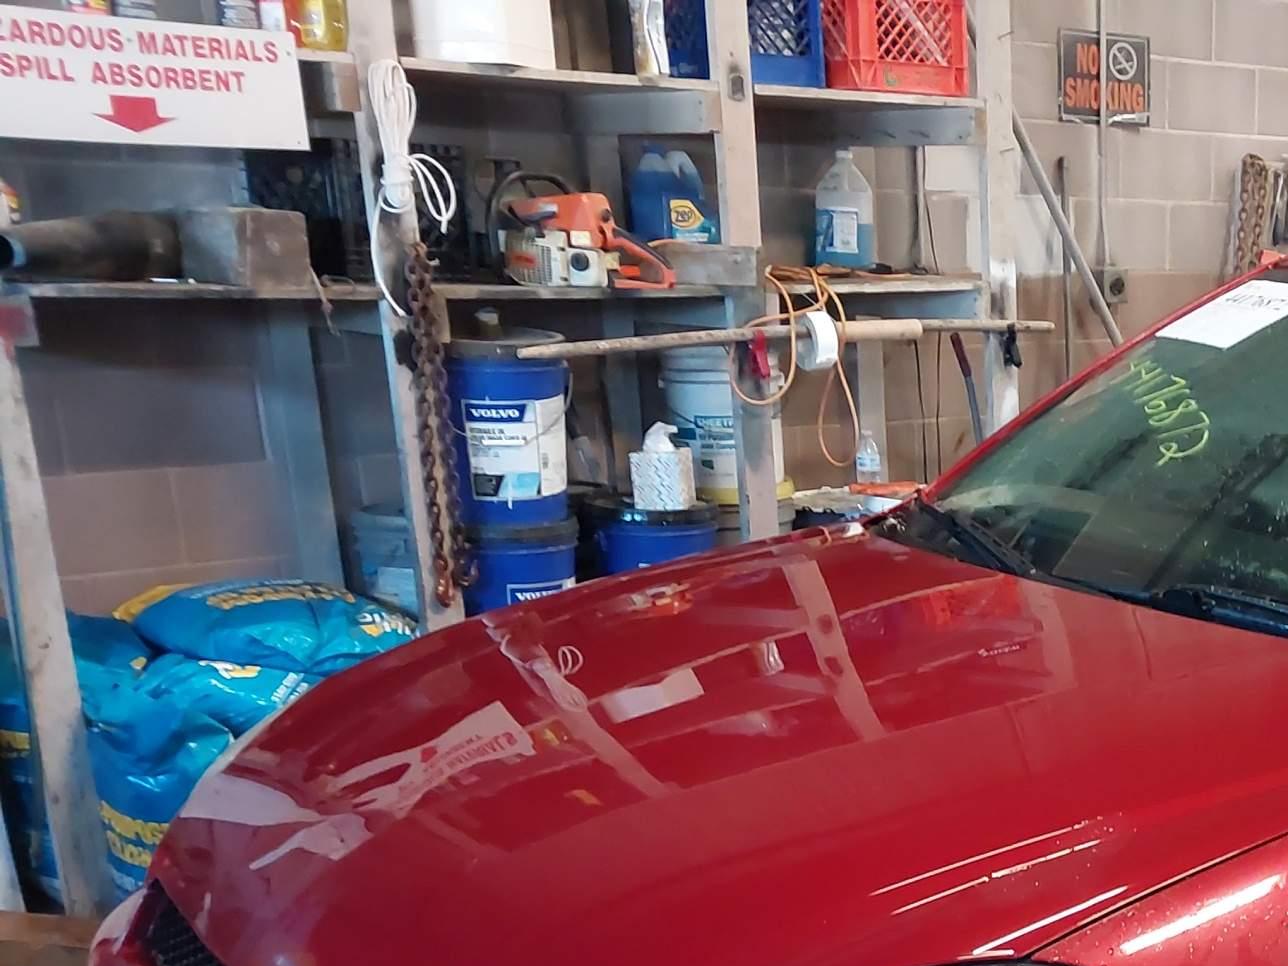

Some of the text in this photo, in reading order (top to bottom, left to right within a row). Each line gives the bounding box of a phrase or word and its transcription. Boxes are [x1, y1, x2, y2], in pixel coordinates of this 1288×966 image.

[0, 18, 279, 63] ARDOUS MATERIALS
[0, 52, 245, 93] SPILL ABSORBENT
[1076, 43, 1100, 75] NO
[470, 408, 520, 419] VOLVO
